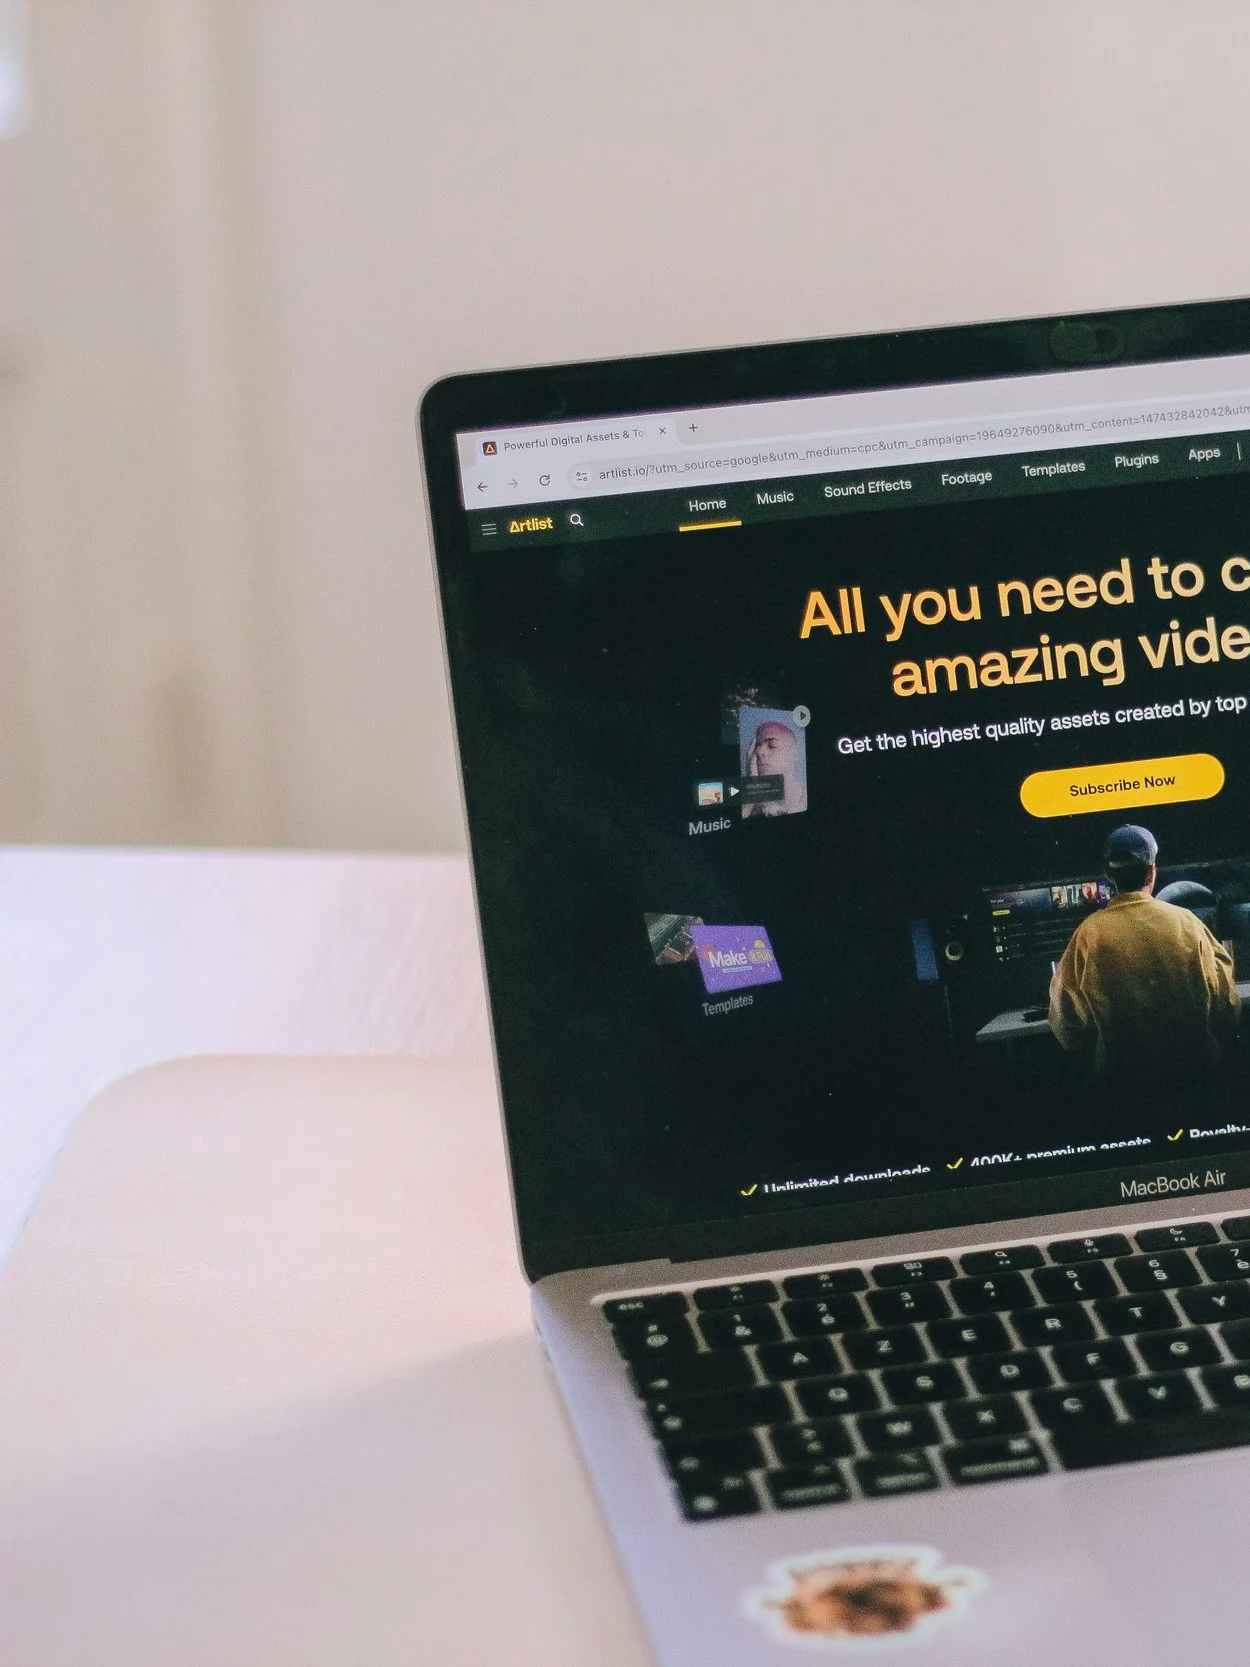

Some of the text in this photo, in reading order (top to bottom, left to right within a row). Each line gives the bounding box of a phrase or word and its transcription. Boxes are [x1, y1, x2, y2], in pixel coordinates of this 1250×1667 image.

[503, 438, 548, 451] Powerful
[551, 434, 583, 447] Digital
[586, 432, 620, 442] Assets
[622, 430, 630, 439] &
[1114, 453, 1160, 469] Plugins
[1188, 447, 1221, 462] Apps
[1021, 461, 1086, 478] Templates
[941, 471, 993, 486] Footage
[824, 478, 912, 498] Sound Effects
[688, 499, 727, 512] Home
[757, 491, 794, 505] Music
[509, 517, 554, 534] Artlist
[800, 587, 866, 639] All
[880, 585, 982, 642] you
[998, 558, 1135, 617] need
[1147, 556, 1205, 601] to
[892, 634, 1126, 697] amazing
[838, 737, 872, 754] Get
[876, 733, 907, 750] the
[911, 724, 981, 748] highest
[985, 717, 1045, 742] quality
[1050, 709, 1110, 731] assets
[1115, 699, 1184, 724] created
[1189, 698, 1211, 718] by
[1215, 695, 1248, 714] top
[1069, 772, 1176, 798] Subscribe Now
[688, 817, 731, 836] Music
[707, 949, 748, 968] Make
[702, 995, 754, 1016] Templates
[1120, 1169, 1226, 1199] MacBook Air
[1230, 1248, 1239, 1257] 7
[1148, 1259, 1159, 1268] 6
[1065, 1270, 1078, 1280] 5
[983, 1281, 995, 1290] 4
[900, 1291, 912, 1301] 3
[1212, 1295, 1227, 1307] Y
[817, 1303, 827, 1312] 2
[1128, 1306, 1143, 1319] T
[1045, 1317, 1064, 1329] R
[961, 1329, 977, 1342] E
[876, 1340, 893, 1353] Z
[793, 1352, 809, 1365] A
[1086, 1352, 1100, 1366] F
[1148, 1385, 1168, 1400] V
[976, 1408, 996, 1425] X
